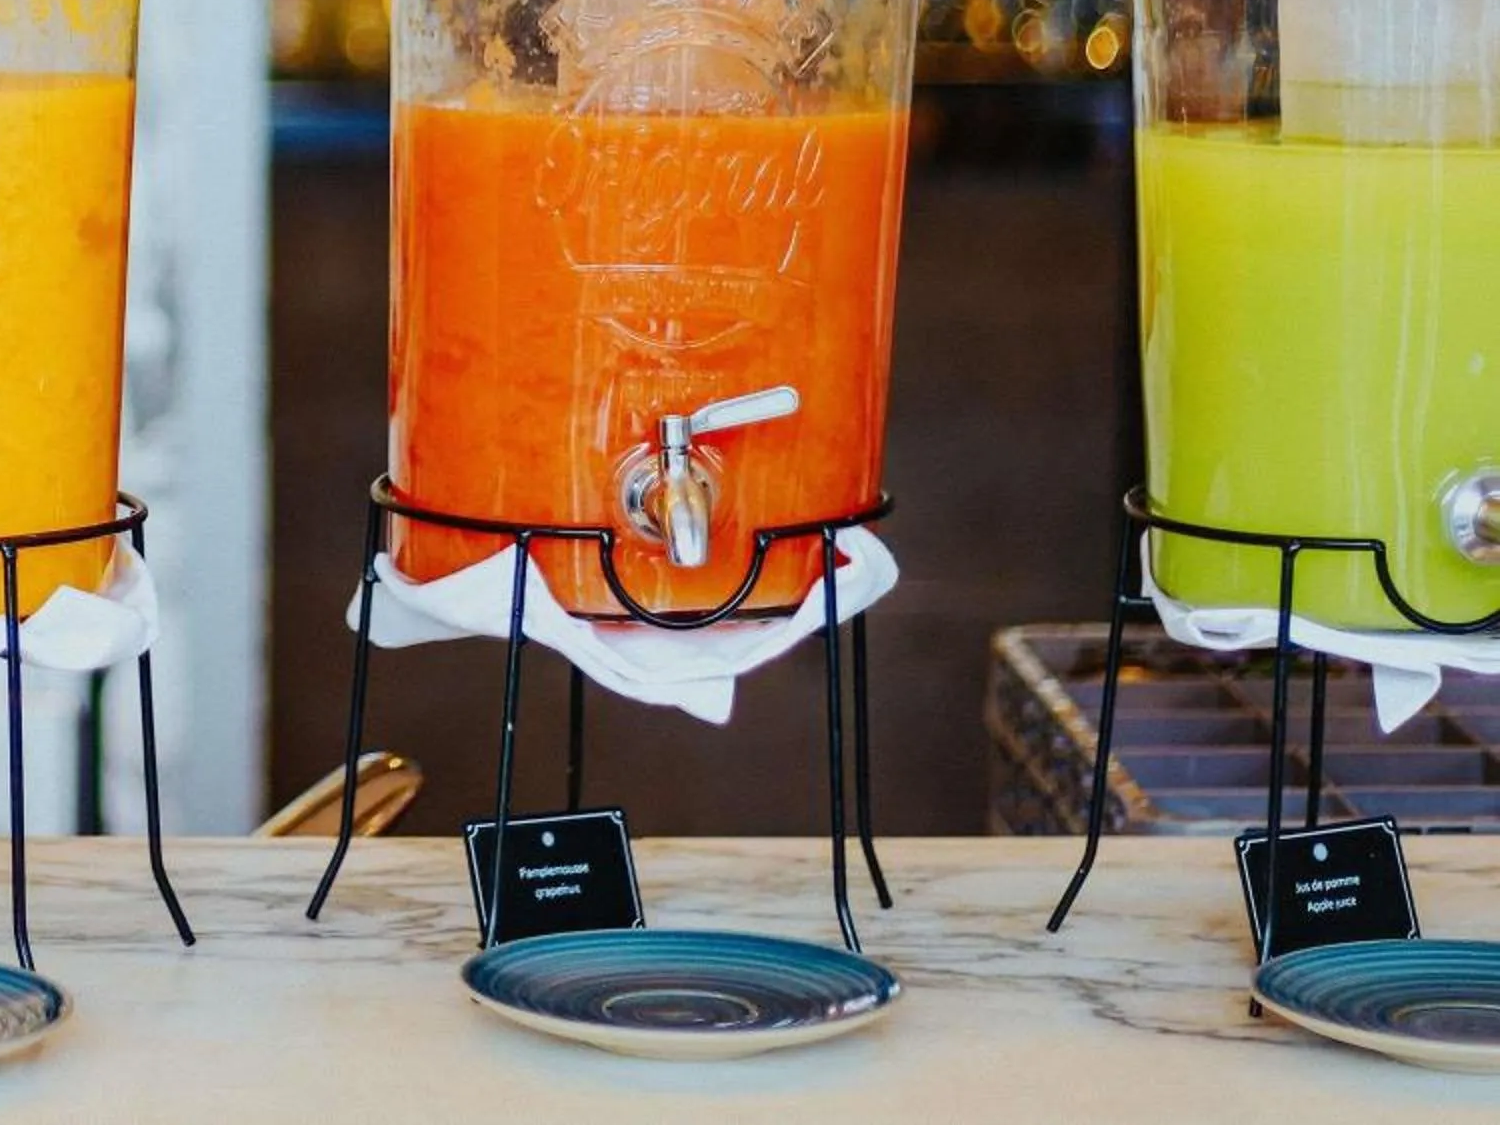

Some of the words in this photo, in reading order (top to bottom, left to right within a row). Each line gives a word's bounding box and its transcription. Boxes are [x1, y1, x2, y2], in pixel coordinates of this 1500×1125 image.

[1295, 881, 1311, 895] Jus
[1311, 878, 1323, 892] de
[1325, 875, 1361, 891] pomme
[1307, 898, 1335, 914] Apple
